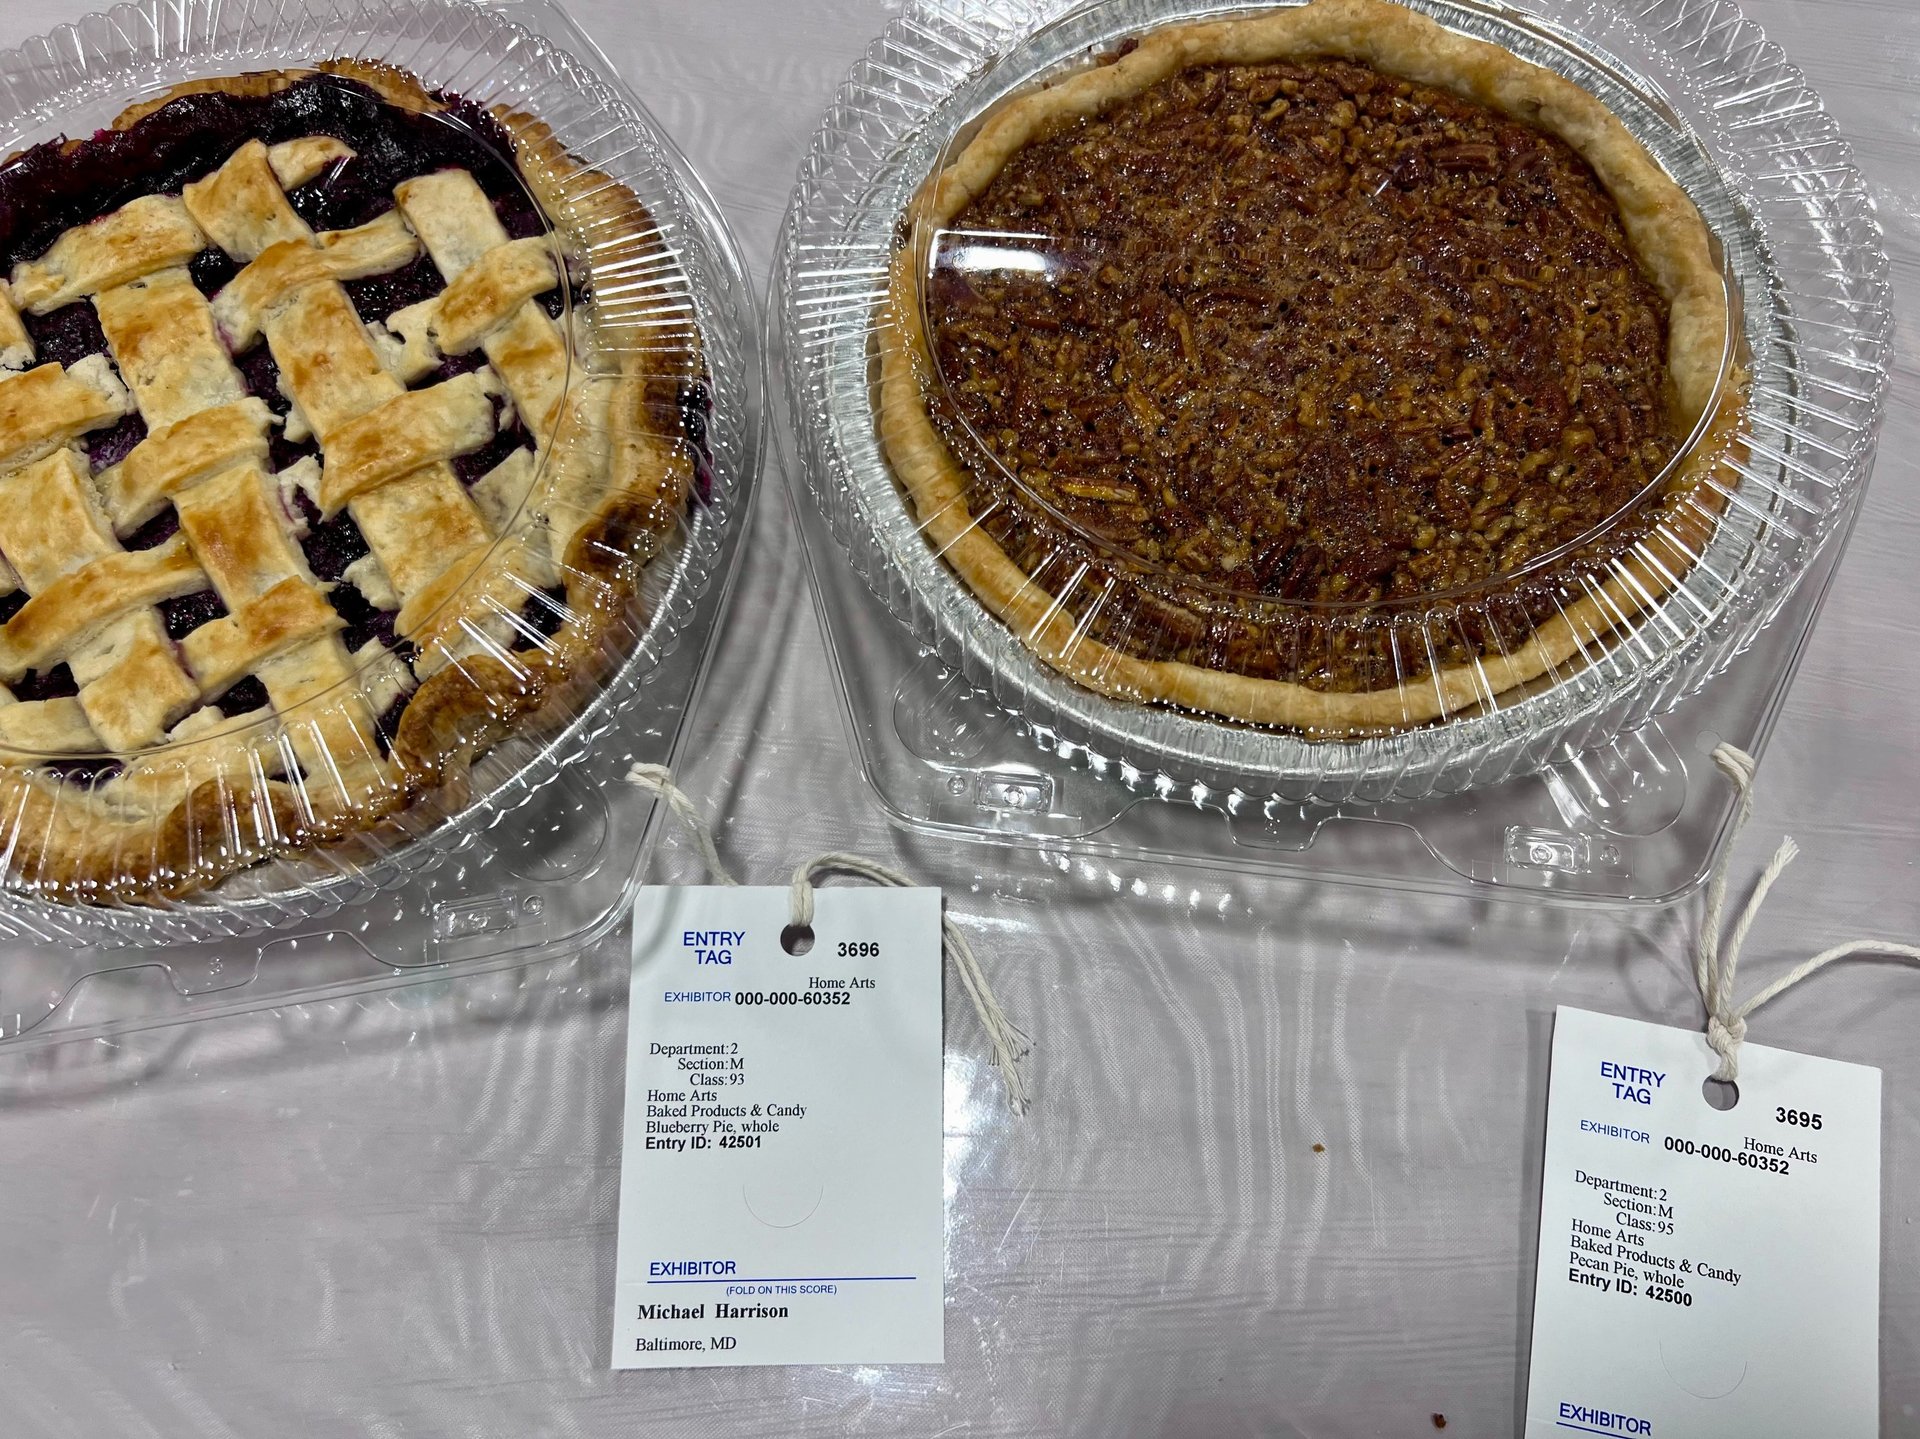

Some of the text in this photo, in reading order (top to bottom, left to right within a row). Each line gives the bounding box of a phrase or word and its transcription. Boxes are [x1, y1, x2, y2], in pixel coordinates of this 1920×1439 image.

[683, 931, 745, 946] ENTRY
[695, 950, 732, 965] TAG
[837, 942, 880, 957] 3696
[809, 976, 876, 989] Home Arts
[664, 992, 851, 1005] EXHIBITOR 000-000-60352
[1600, 1061, 1667, 1088] ENTRY
[647, 1089, 718, 1102] Home Arts
[1611, 1082, 1652, 1105] TAG
[646, 1104, 807, 1118] Baked Products & Candy
[1775, 1106, 1823, 1131] 3695
[645, 1120, 780, 1135] Blueberry Pie, whole
[645, 1135, 761, 1152] Entry ID: 42501
[1580, 1119, 1790, 1175] EXHIBITOR 000-000-60352
[1743, 1136, 1818, 1164] Home Arts
[1571, 1218, 1645, 1247] Home Arts
[649, 1260, 737, 1276] EXHIBITOR
[1570, 1234, 1742, 1287] Baked Products & Candy
[1569, 1252, 1685, 1289] Pecan Pie, whole
[725, 1284, 838, 1297] (FOLD ON THIS SCORE)
[1568, 1268, 1693, 1308] Entry ID: 42500
[637, 1302, 789, 1320] Michael Harrison
[635, 1336, 737, 1353] Baltimore, MD
[1559, 1402, 1652, 1436] EXHIBITOR
